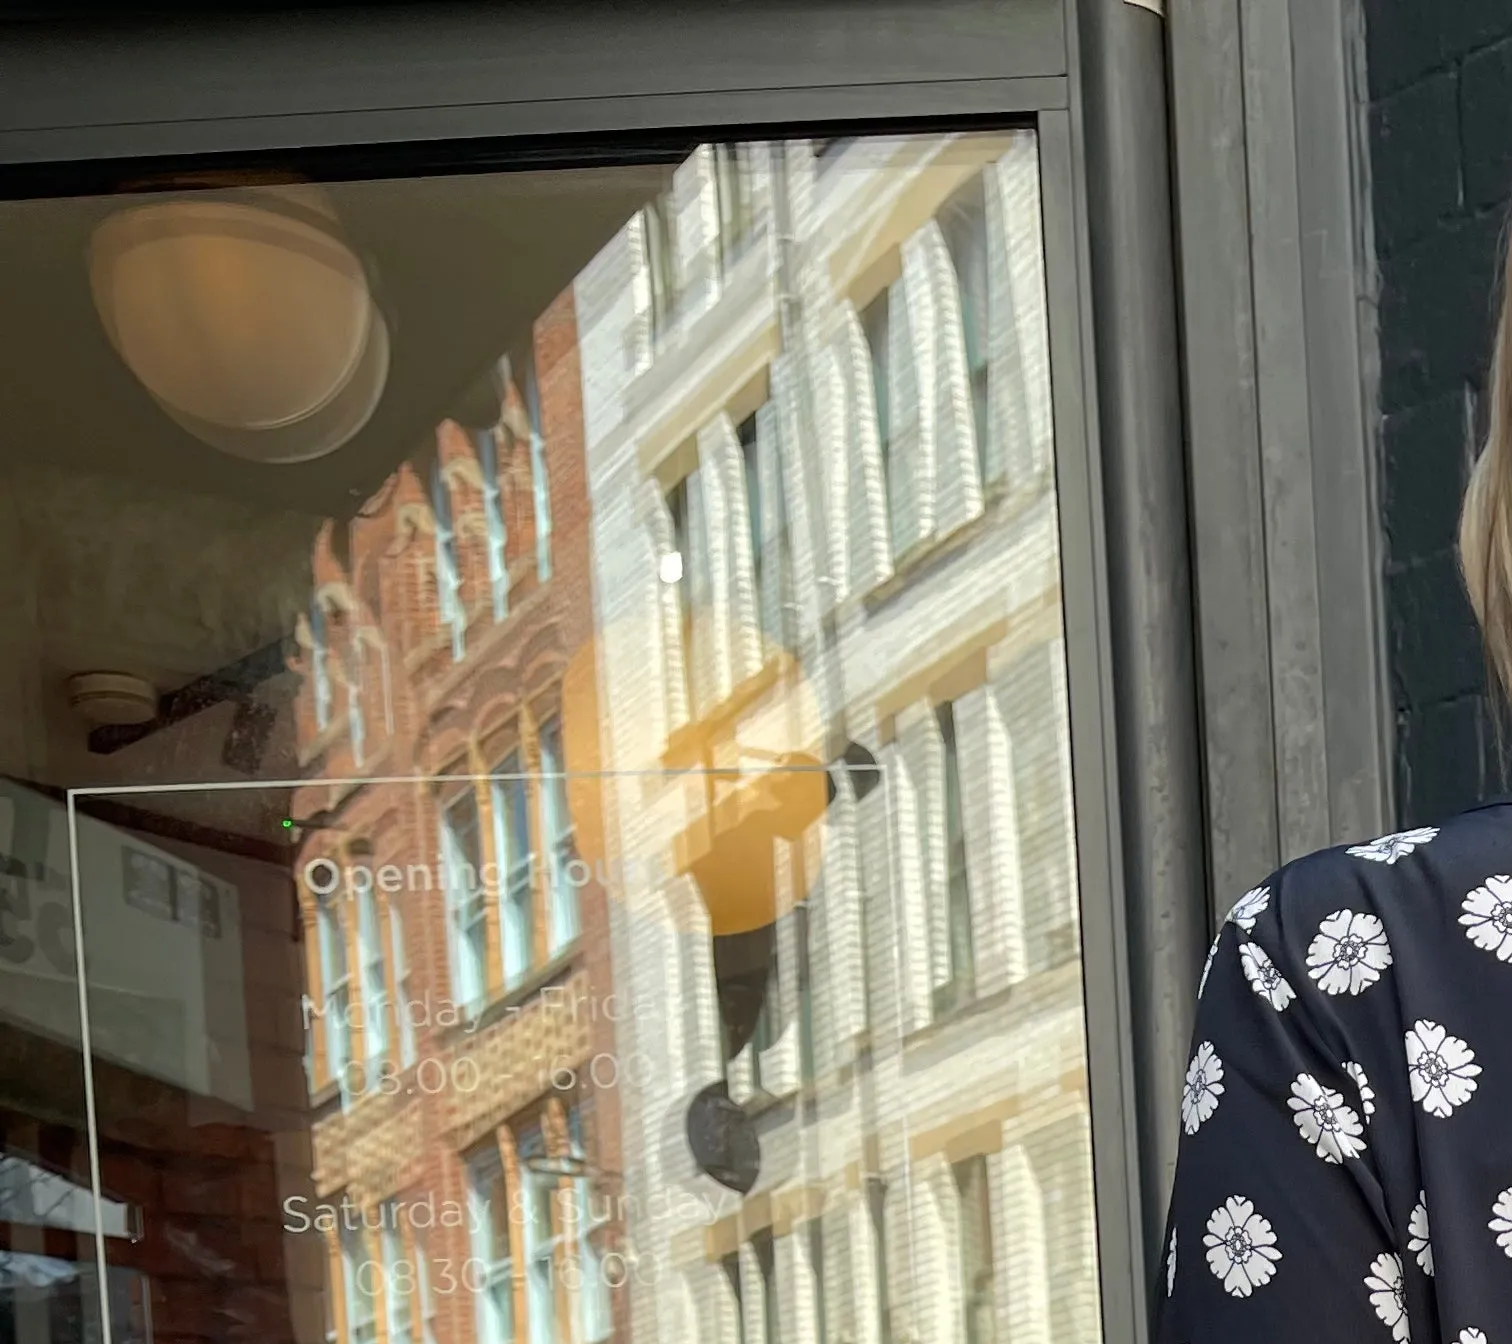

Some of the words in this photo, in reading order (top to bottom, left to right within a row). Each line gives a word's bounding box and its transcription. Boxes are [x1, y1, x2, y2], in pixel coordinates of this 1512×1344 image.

[304, 851, 503, 901] Opening
[528, 854, 648, 889] Hou
[302, 988, 485, 1033] Monday
[541, 983, 672, 1027] Frida
[282, 1187, 492, 1235] Saturday
[509, 1188, 539, 1225] &
[557, 1185, 727, 1226] Sunday
